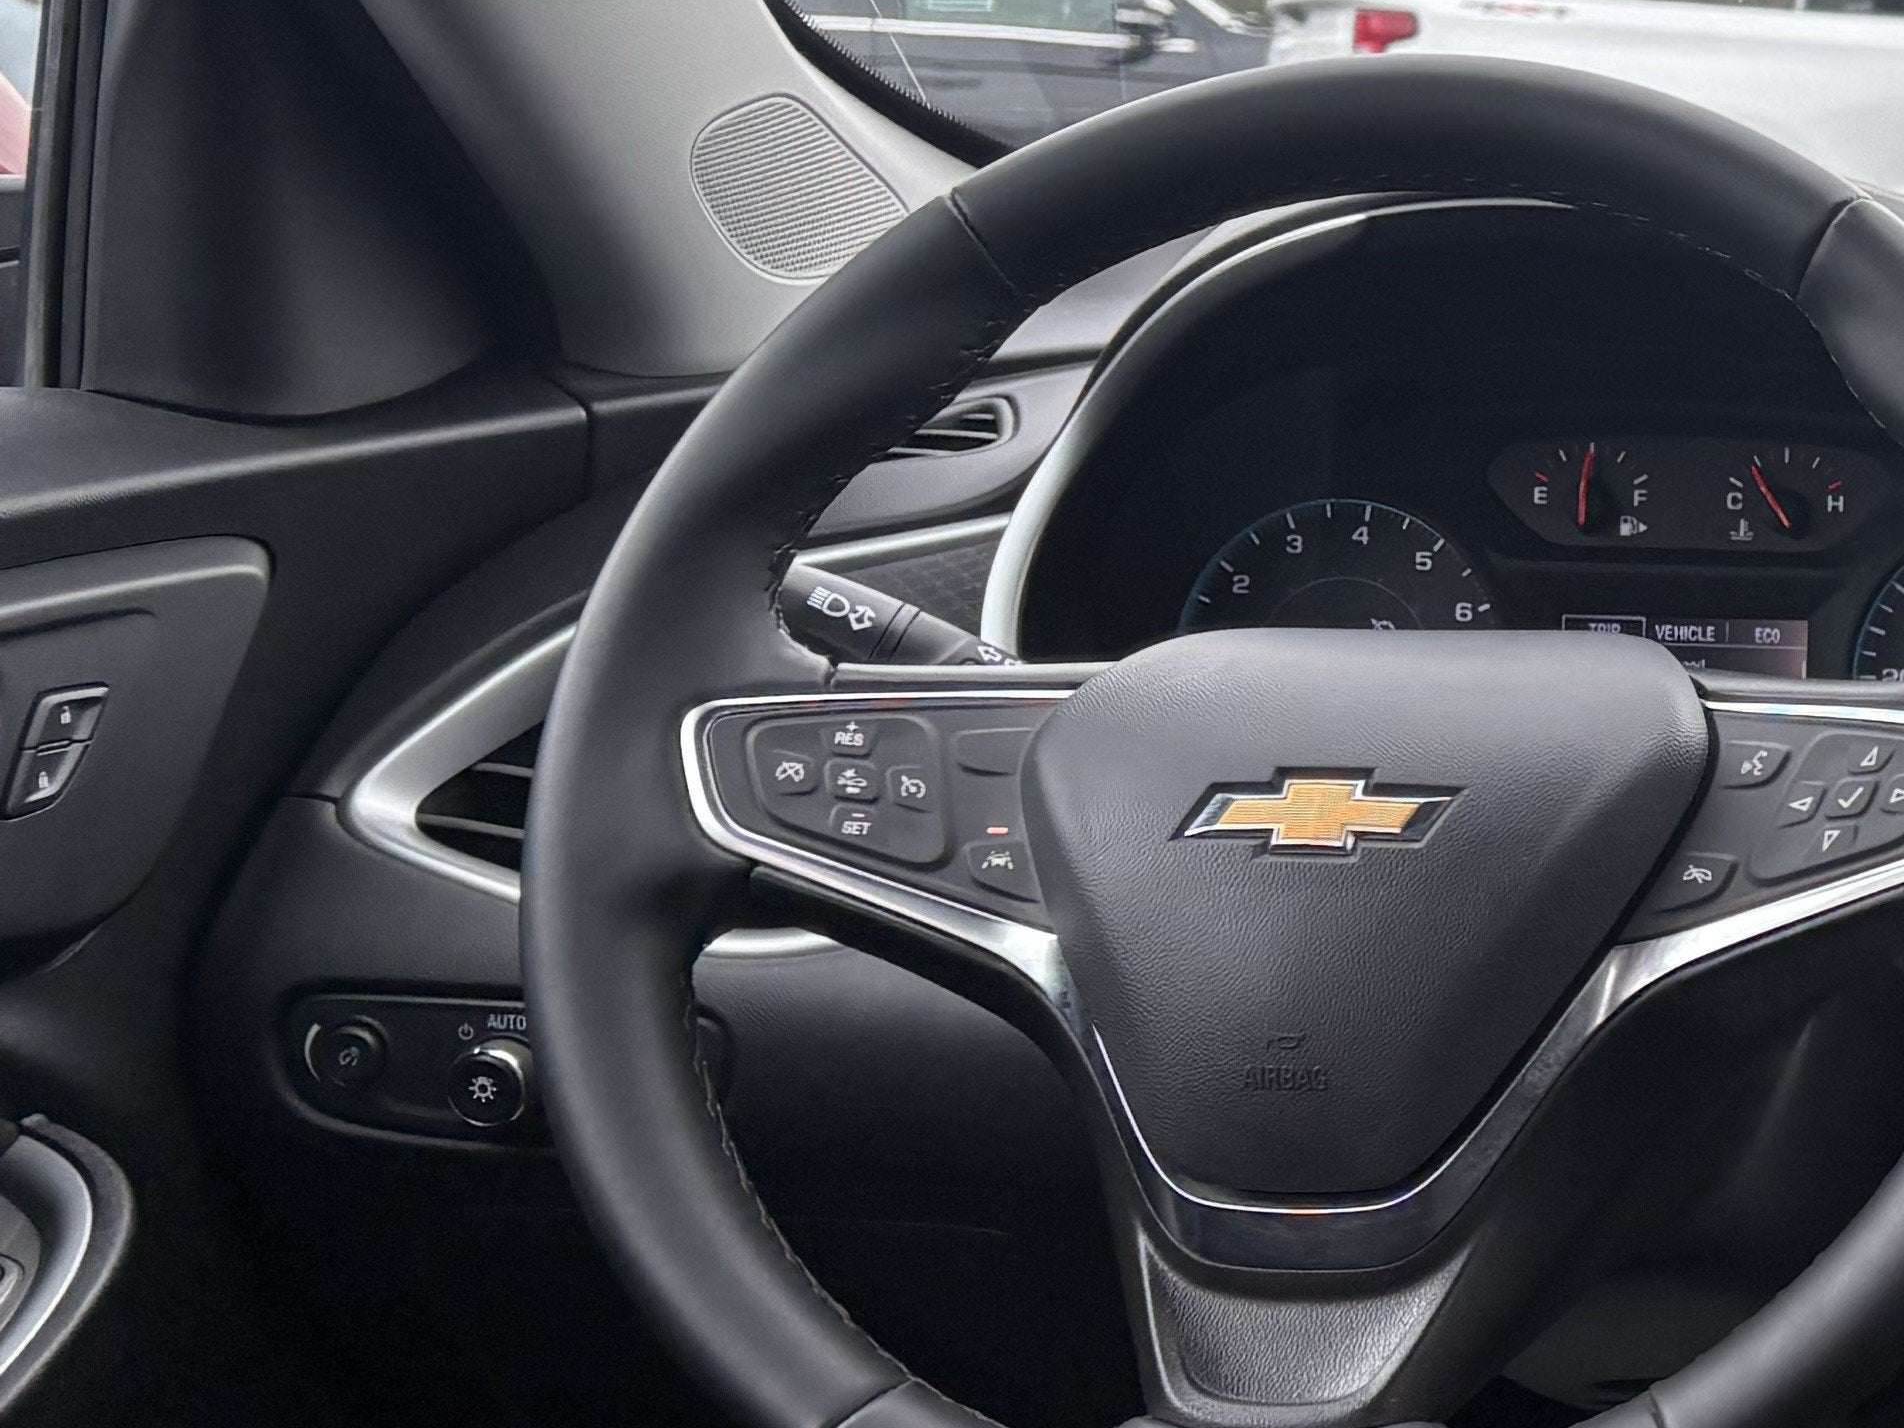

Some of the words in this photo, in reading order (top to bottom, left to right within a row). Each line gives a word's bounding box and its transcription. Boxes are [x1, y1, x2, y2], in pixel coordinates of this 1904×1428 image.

[1533, 487, 1547, 504] E
[1633, 489, 1647, 507] F
[1727, 491, 1742, 510] C
[1827, 495, 1844, 513] H
[1286, 534, 1303, 554] 3
[1352, 526, 1370, 545] 4
[1415, 551, 1433, 570] 5
[1232, 575, 1250, 594] 2
[1455, 602, 1473, 622] 6
[1654, 625, 1716, 642] VEHICLE
[1755, 627, 1781, 644] ECO
[834, 731, 864, 747] RES
[841, 821, 872, 835] SET
[487, 1013, 527, 1031] AUTO
[1242, 1064, 1328, 1091] AIRBAG
